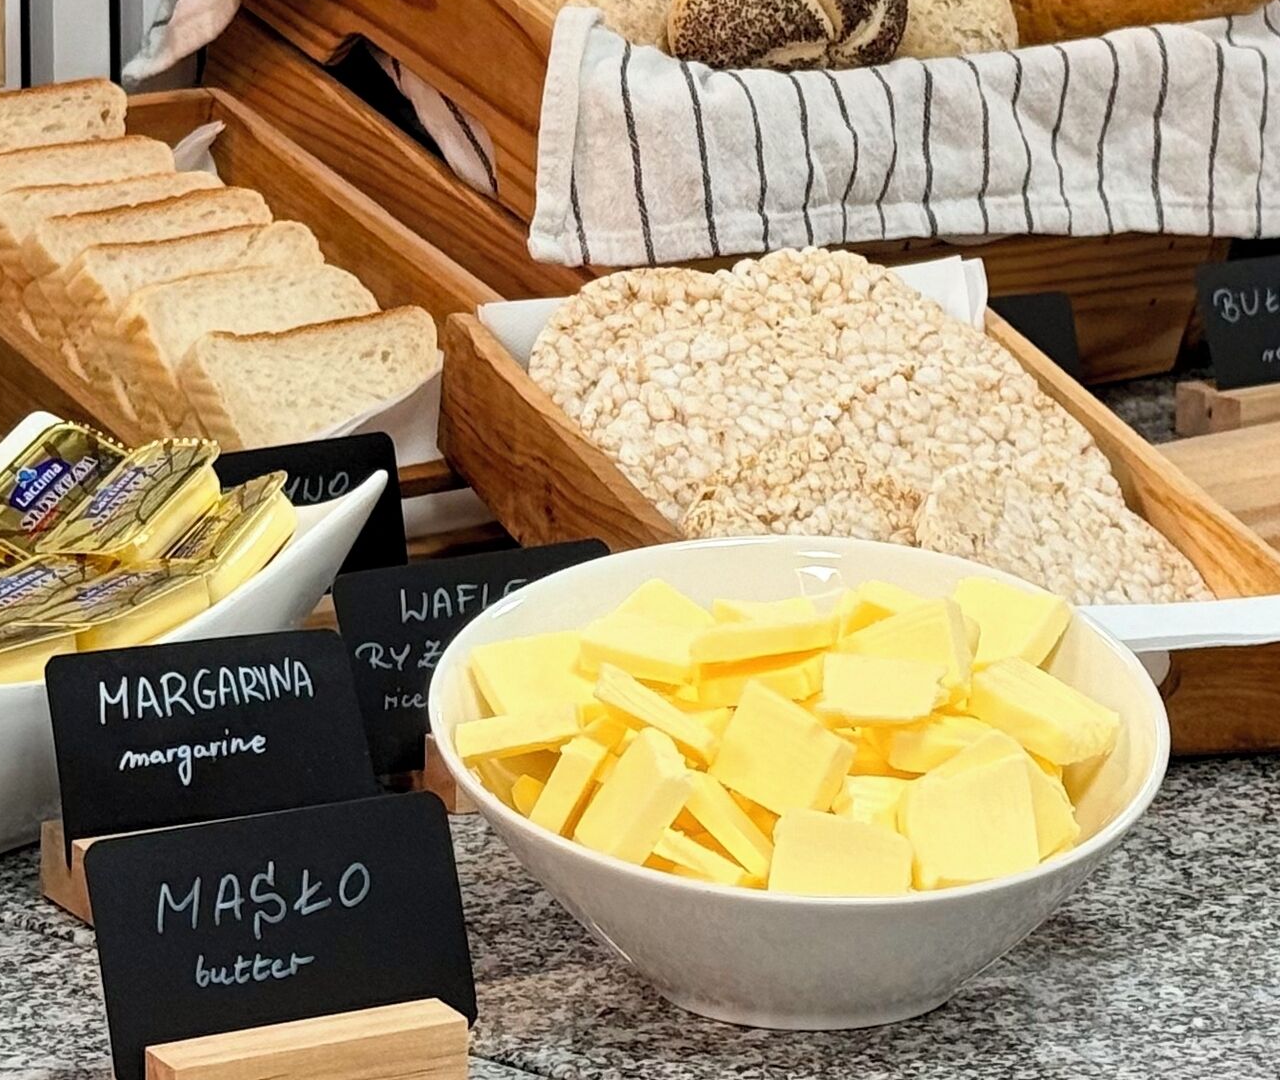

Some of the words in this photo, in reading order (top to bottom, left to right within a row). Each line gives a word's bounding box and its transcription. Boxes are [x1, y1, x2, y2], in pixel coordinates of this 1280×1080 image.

[99, 656, 314, 725] MARGARYNA
[119, 728, 267, 786] margarine
[195, 952, 315, 988] butter
